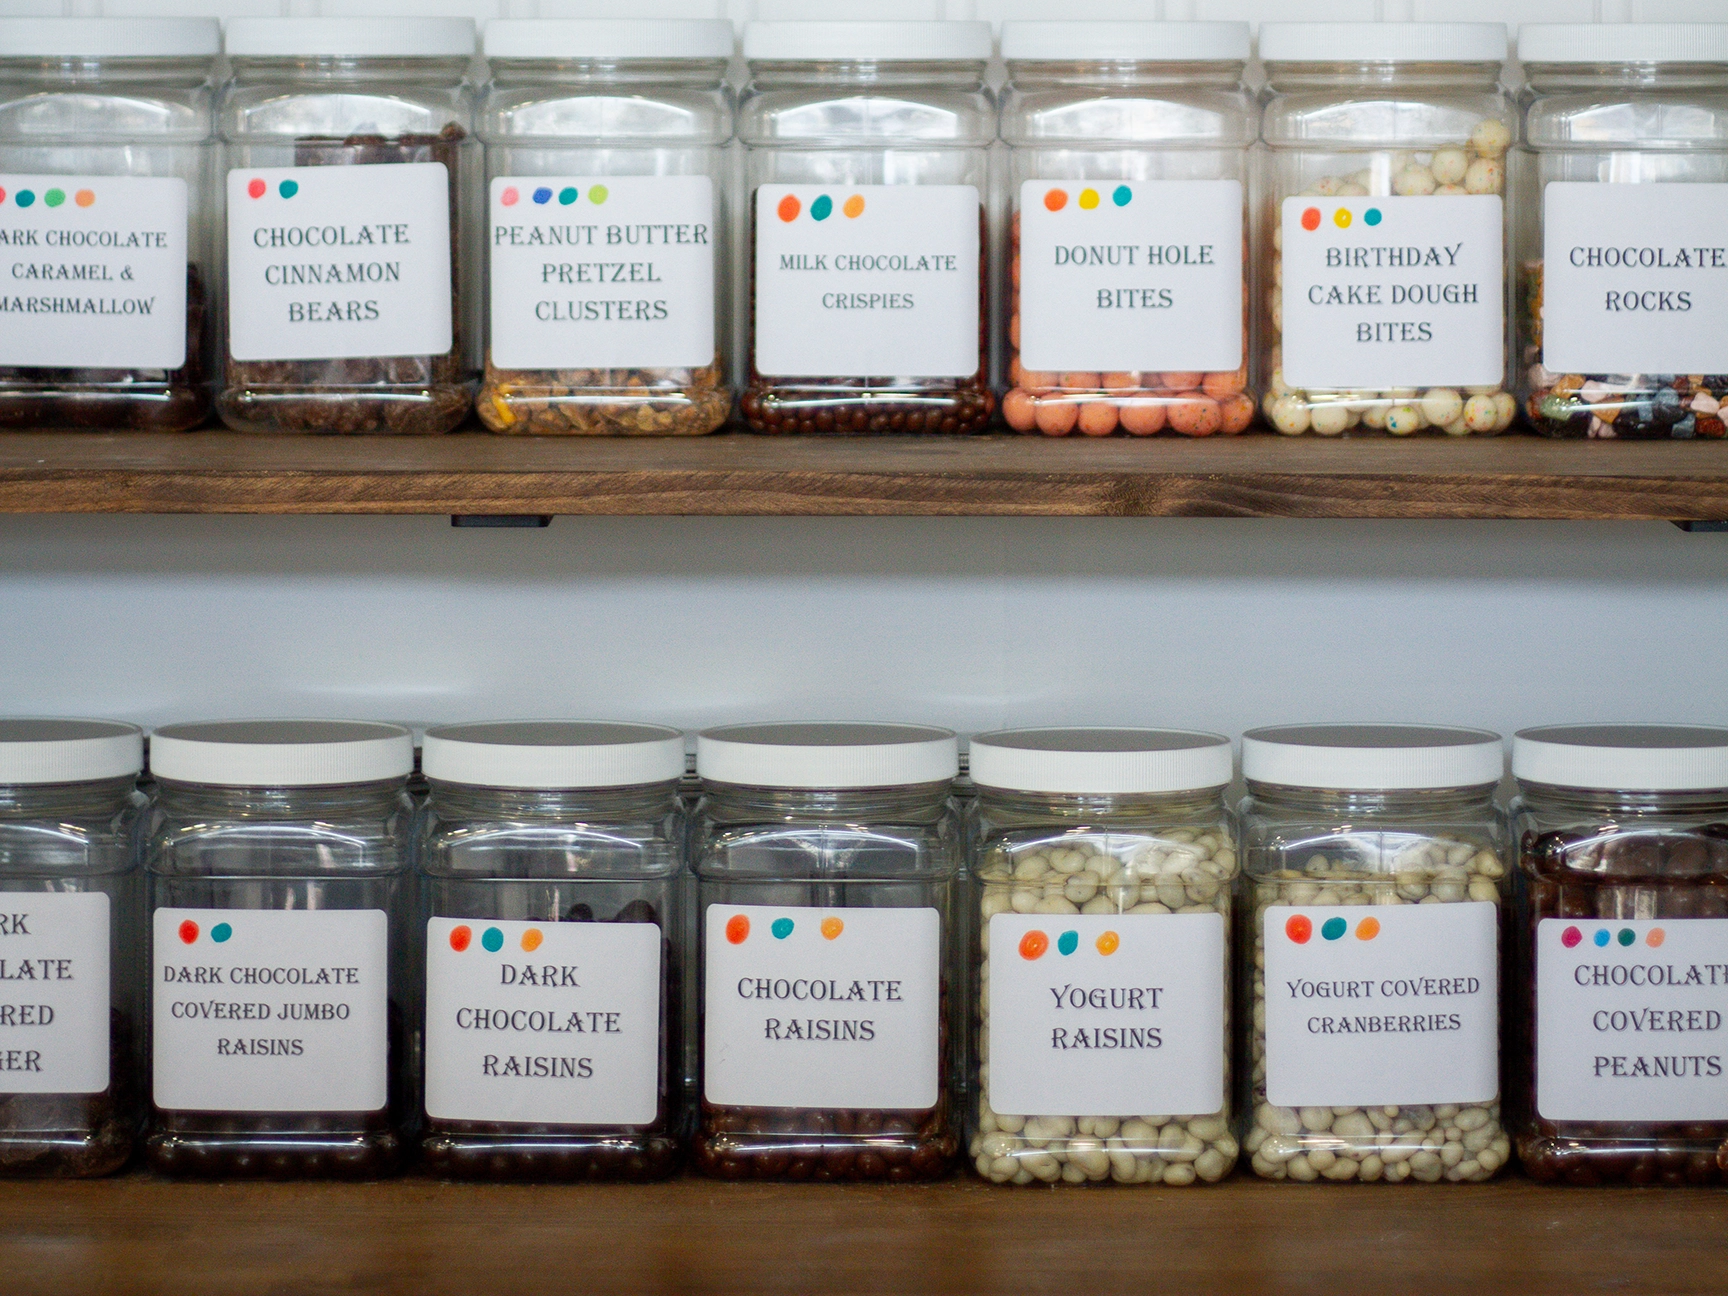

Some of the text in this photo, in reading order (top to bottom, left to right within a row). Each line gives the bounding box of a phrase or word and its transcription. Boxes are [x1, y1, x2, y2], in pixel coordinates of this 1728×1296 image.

[45, 230, 167, 248] CHOCOLATE
[253, 224, 410, 248] CHOCOLATE
[495, 224, 708, 246] PEANUT BUTTER
[780, 254, 957, 271] MILK CHOCOLATE
[1055, 245, 1214, 265] DONUT HOLE
[1326, 242, 1463, 268] BIRTHDAY
[1569, 247, 1727, 268] CHOCOLATE
[12, 263, 134, 281] CARAMEL &
[265, 262, 399, 285] CINNAMON
[542, 263, 662, 284] PRETZEL
[822, 293, 914, 310] CRISPIES
[1097, 289, 1173, 309] BITES
[1308, 284, 1478, 305] CAKE DOUGH
[1605, 291, 1692, 312] ROCKS
[289, 300, 379, 323] BEARS
[535, 300, 668, 321] CLUSTERS
[1356, 322, 1433, 342] BITES
[164, 966, 360, 985] DARK CHOCOLATE
[501, 964, 580, 988] DARK
[737, 977, 903, 1002] CHOCOLATE
[1050, 984, 1164, 1011] YOGURT
[1286, 977, 1480, 999] YOGURT COVERED
[171, 1000, 350, 1021] COVERED JUMBO
[456, 1007, 622, 1033] CHOCOLATE
[1593, 1007, 1722, 1033] COVERED
[764, 1018, 875, 1041] RAISINS
[1307, 1013, 1461, 1034] CRANBERRIES
[217, 1038, 304, 1056] RAISINS
[1051, 1027, 1163, 1050] RAISINS
[482, 1054, 593, 1079] RAISINS
[1593, 1055, 1722, 1077] PEANUTS
